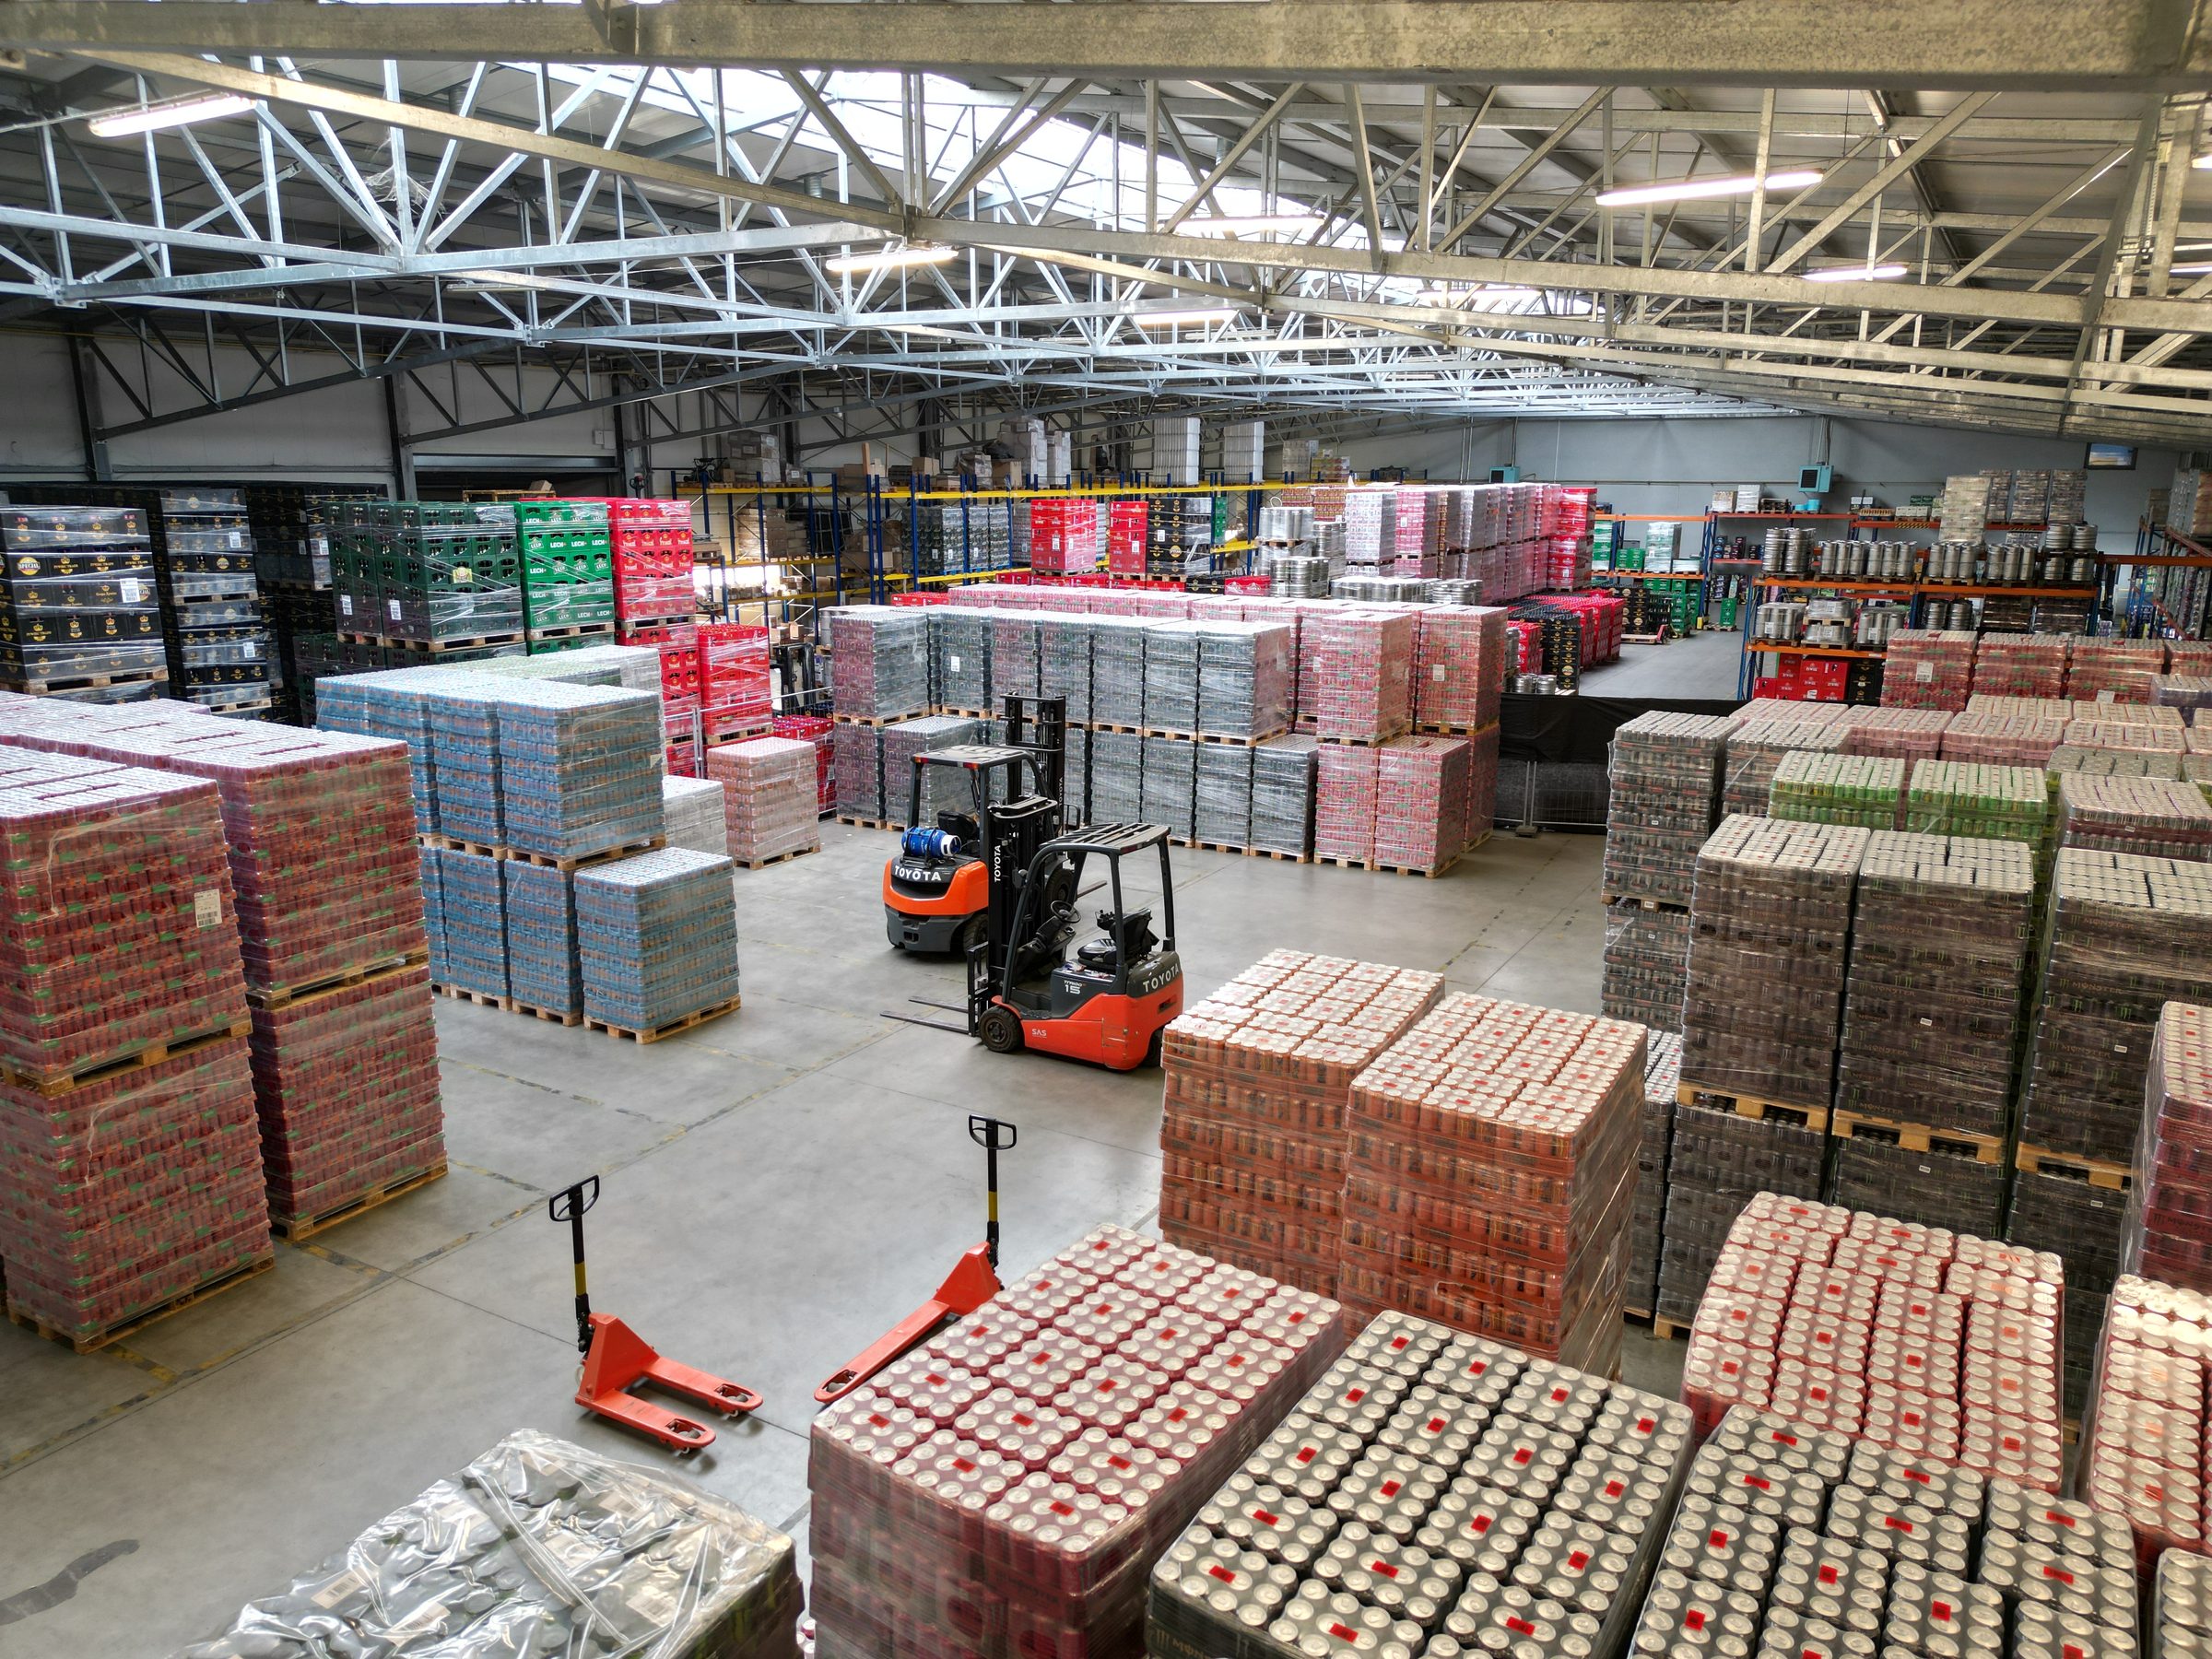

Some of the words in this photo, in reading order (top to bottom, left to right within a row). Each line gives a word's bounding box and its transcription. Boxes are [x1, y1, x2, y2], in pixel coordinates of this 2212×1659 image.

[895, 865, 941, 881] TOYOTA
[1877, 924, 1924, 935] MONSTER
[2084, 917, 2135, 930] MONSTER
[1143, 963, 1179, 993] TOYOTA
[1065, 984, 1080, 994] 15
[1871, 985, 1916, 996] MONSTER
[1958, 996, 2006, 1008] MONSTER
[1032, 1029, 1047, 1037] SAS
[1864, 1044, 1909, 1056] MONSTER
[1859, 1102, 1903, 1115] MONSTER
[1943, 1117, 1991, 1129] MONSTER
